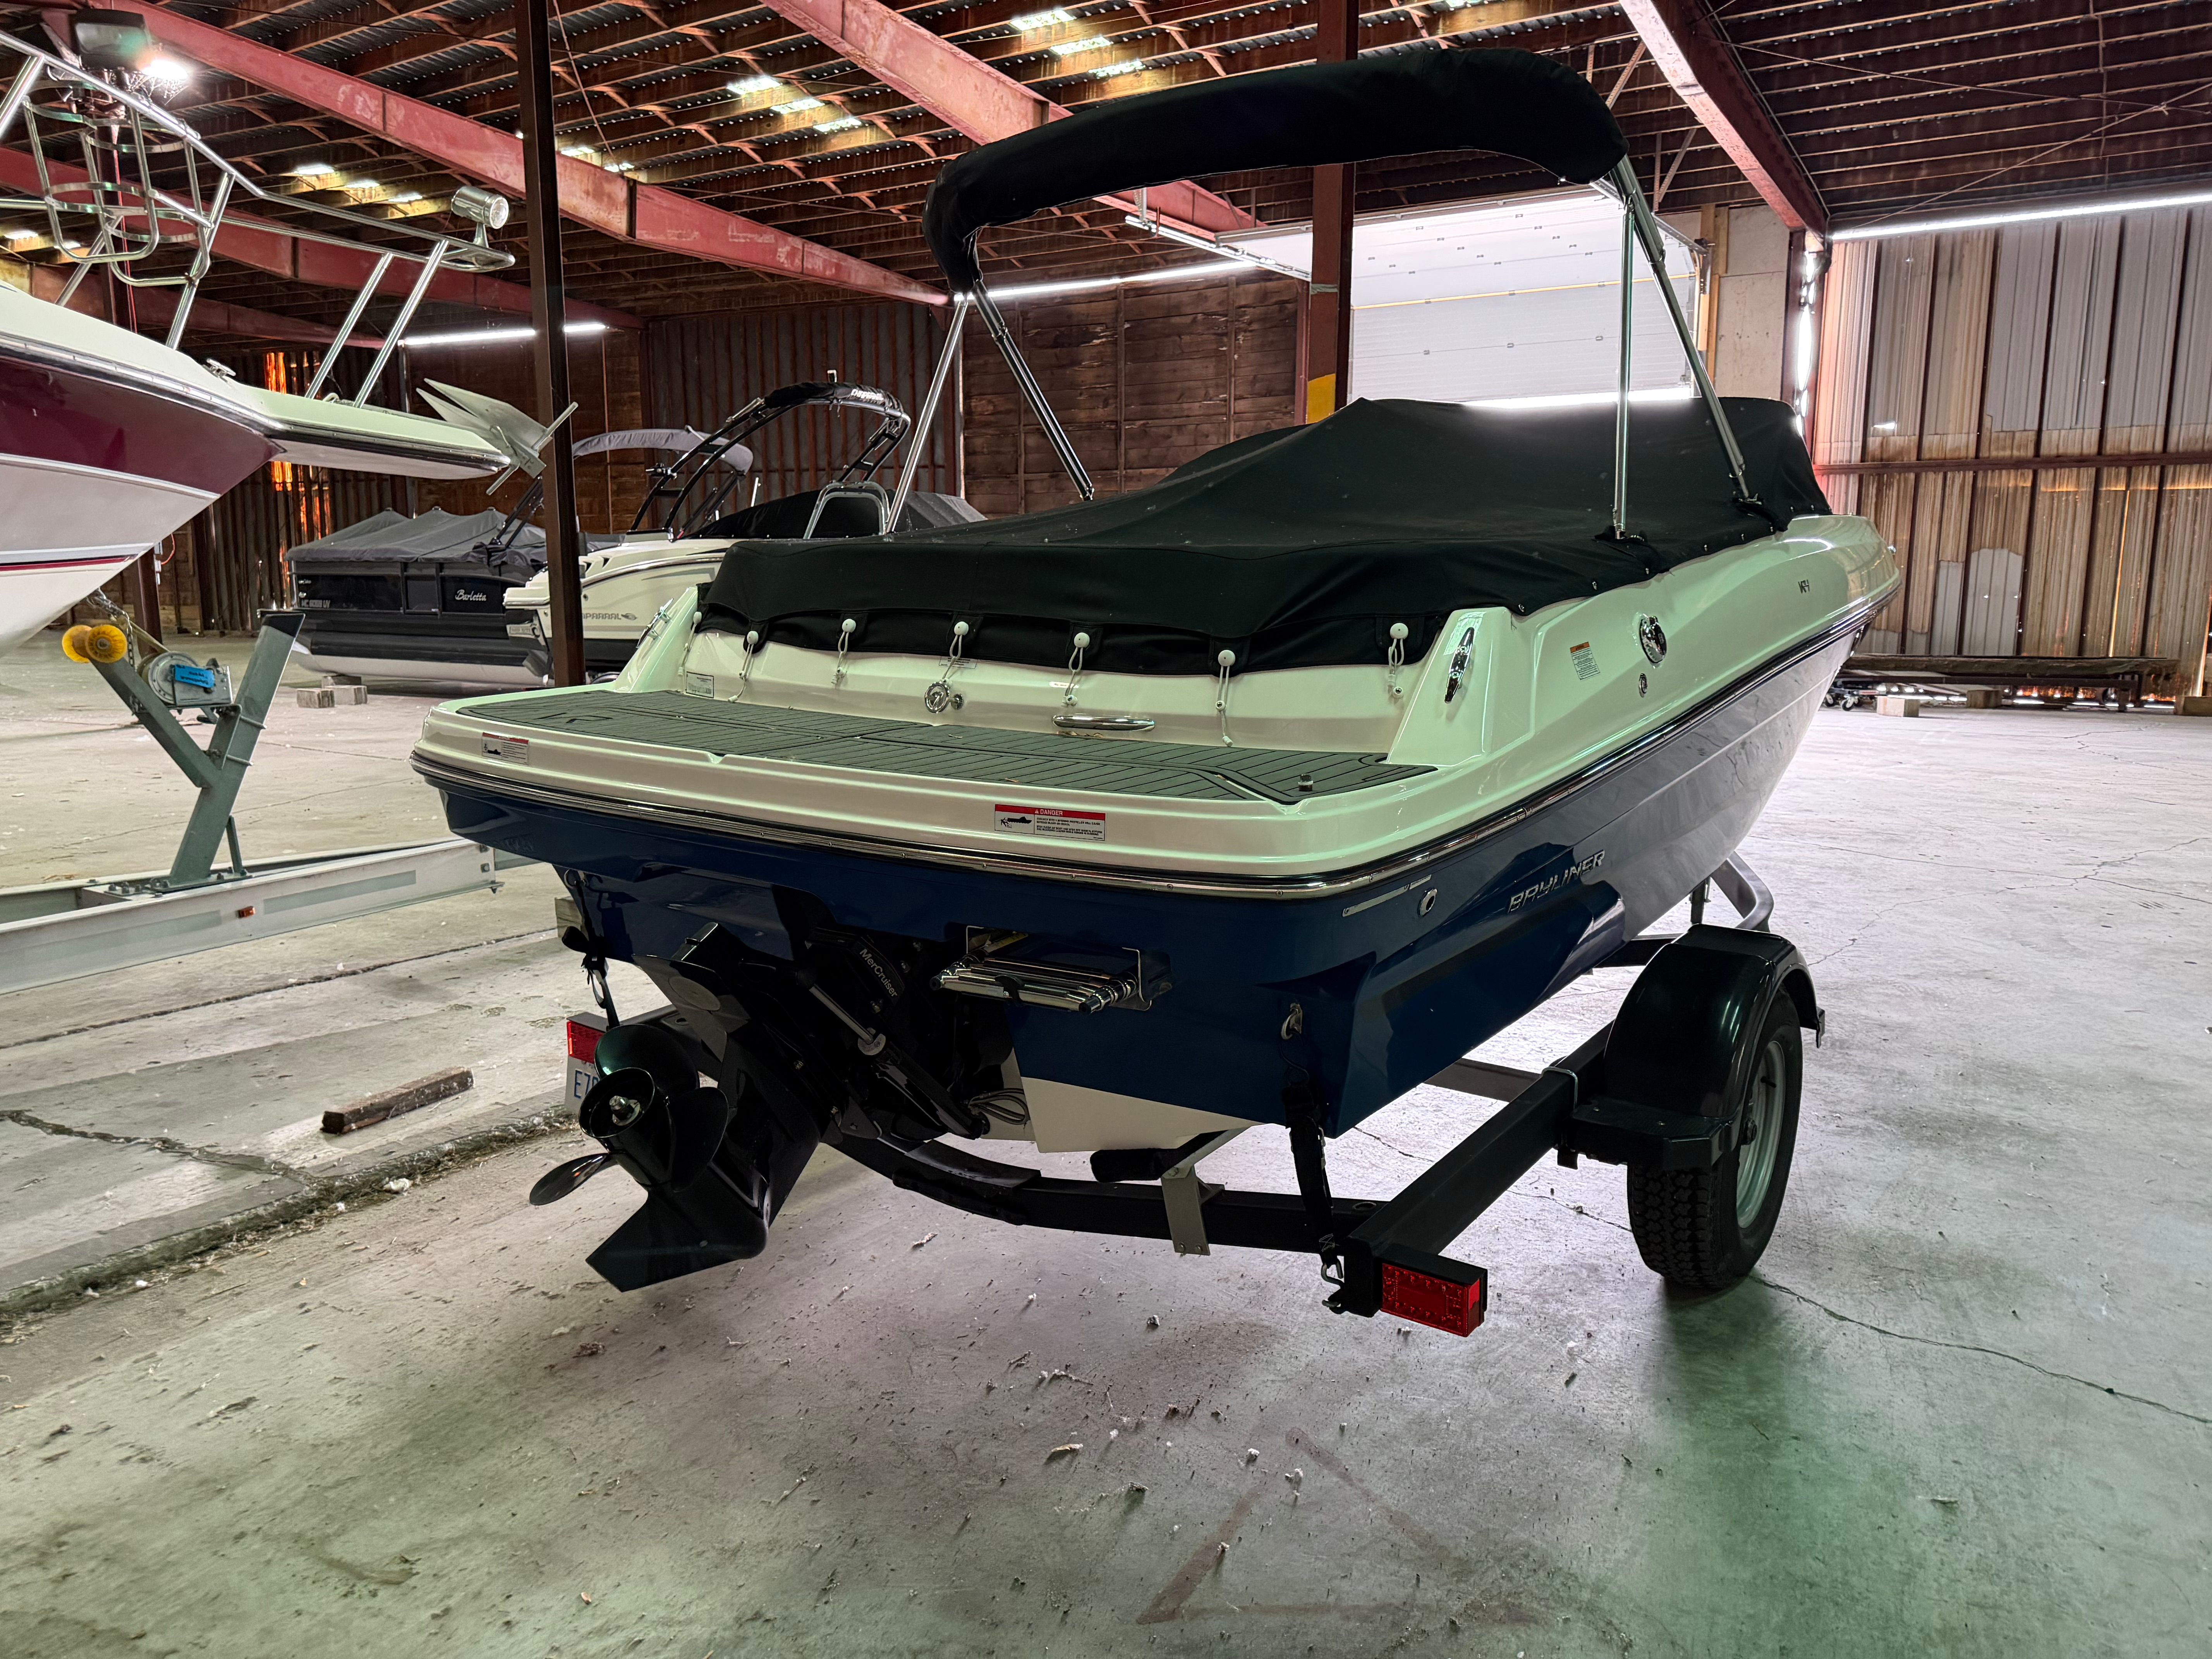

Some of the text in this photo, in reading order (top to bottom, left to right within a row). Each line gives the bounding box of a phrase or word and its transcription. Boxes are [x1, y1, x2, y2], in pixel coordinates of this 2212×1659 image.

[455, 589, 486, 601] Barletta
[1508, 849, 1605, 914] BAYLINER
[859, 948, 897, 997] MerCruiser
